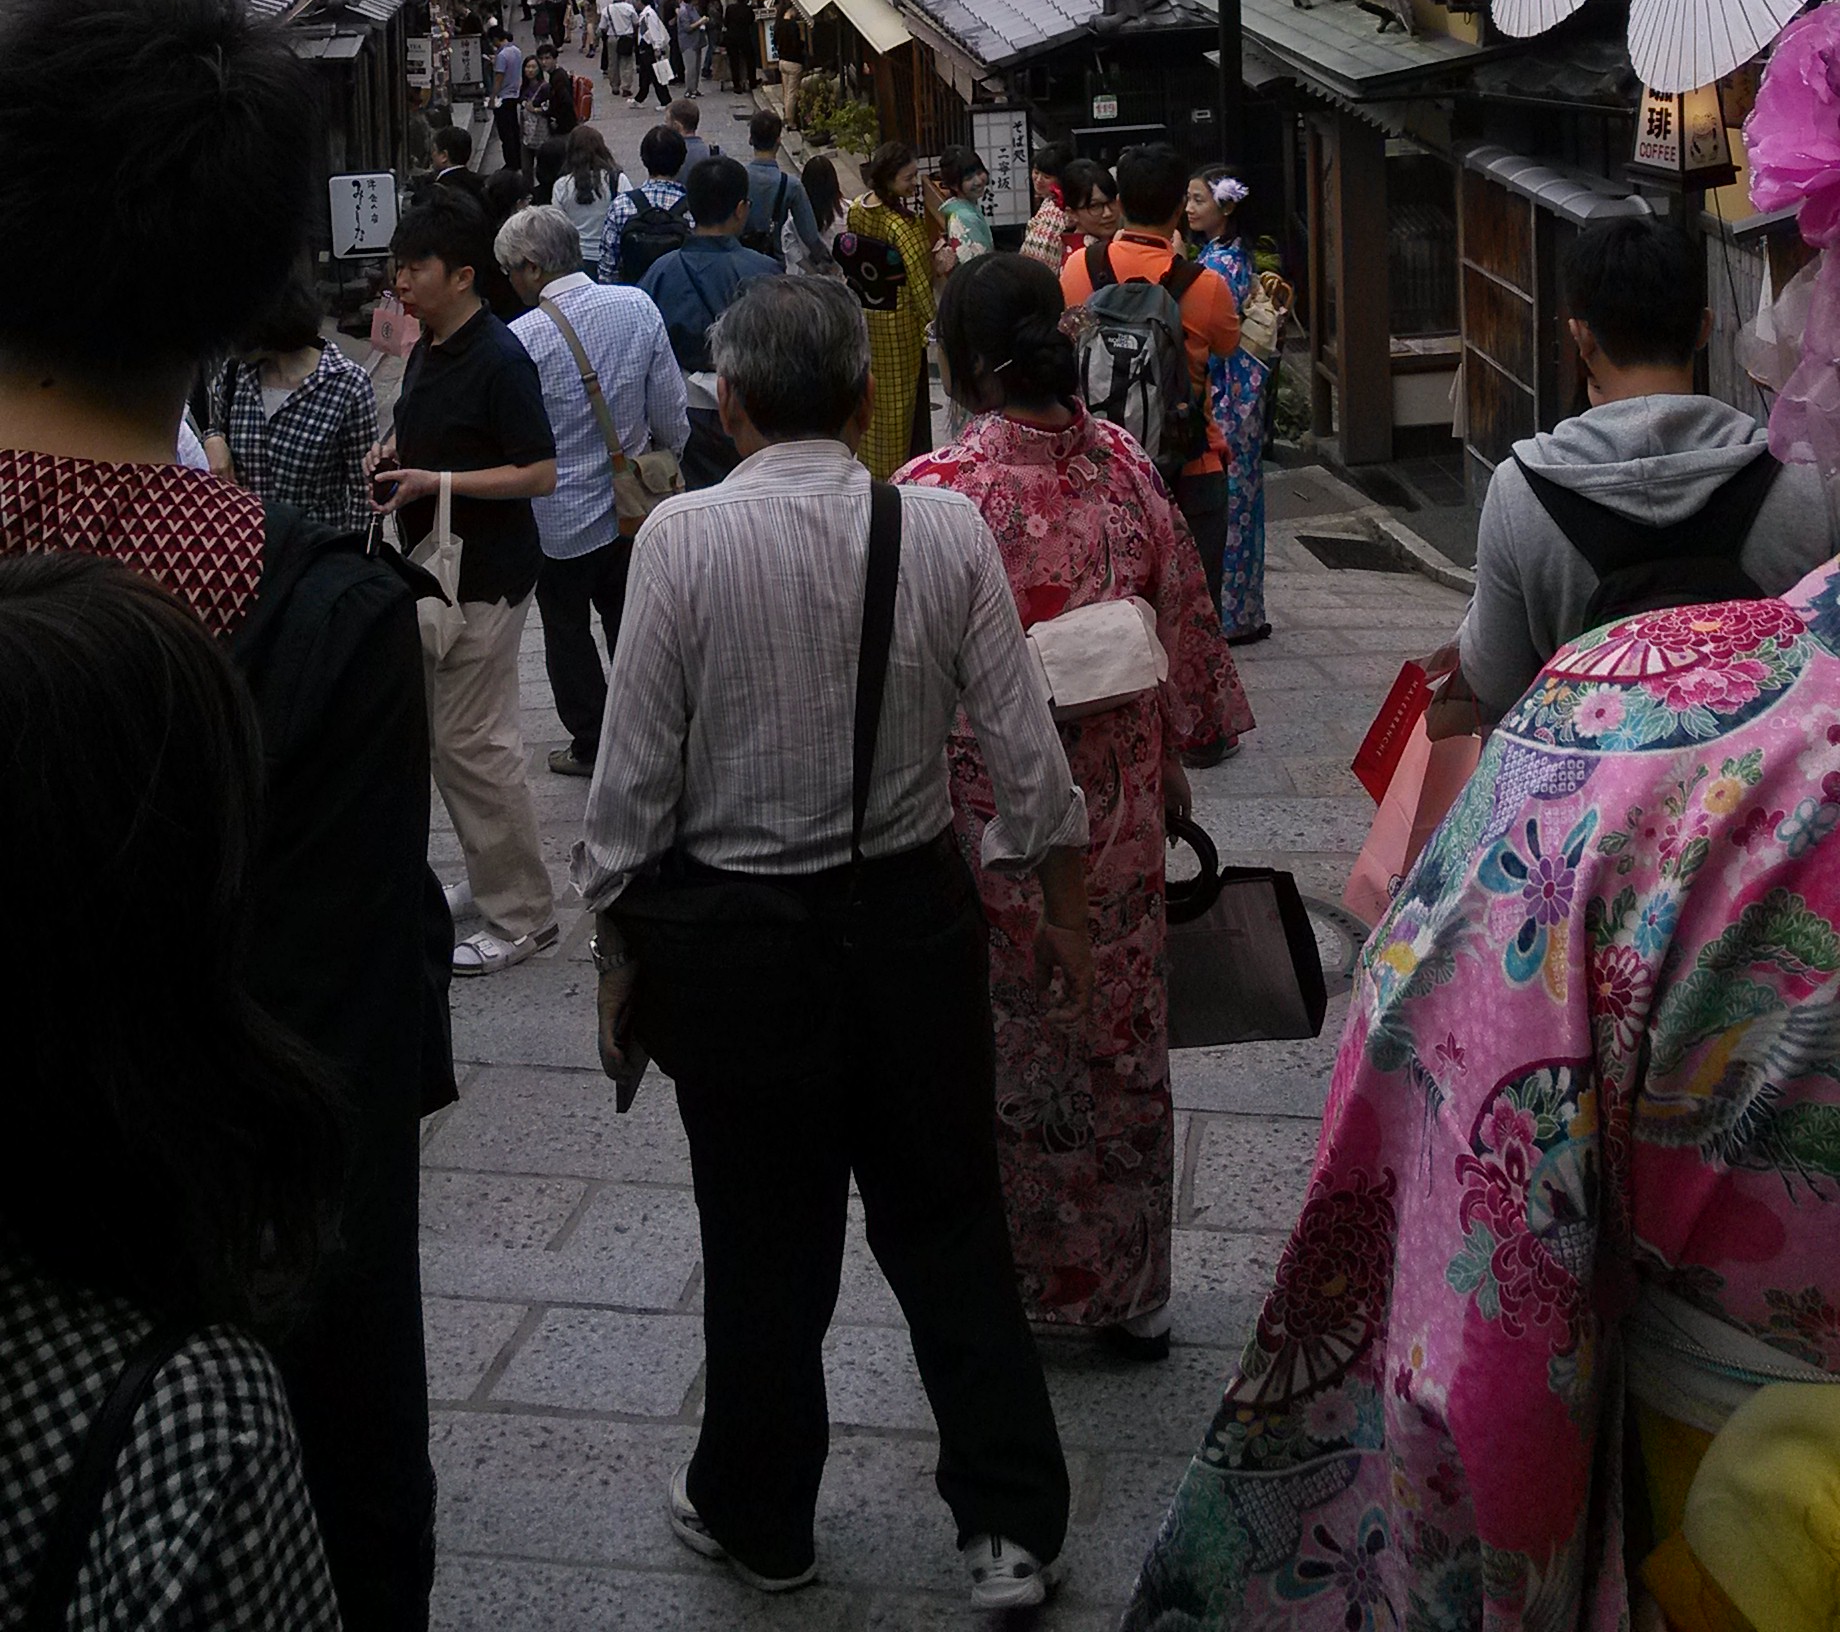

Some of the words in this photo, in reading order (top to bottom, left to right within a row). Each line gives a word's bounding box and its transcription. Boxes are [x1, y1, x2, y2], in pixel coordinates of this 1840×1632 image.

[1012, 120, 1026, 163] そば処
[1639, 142, 1677, 163] COFFEE
[981, 179, 999, 217] たば
[1375, 680, 1419, 758] MALEBRANCHE
